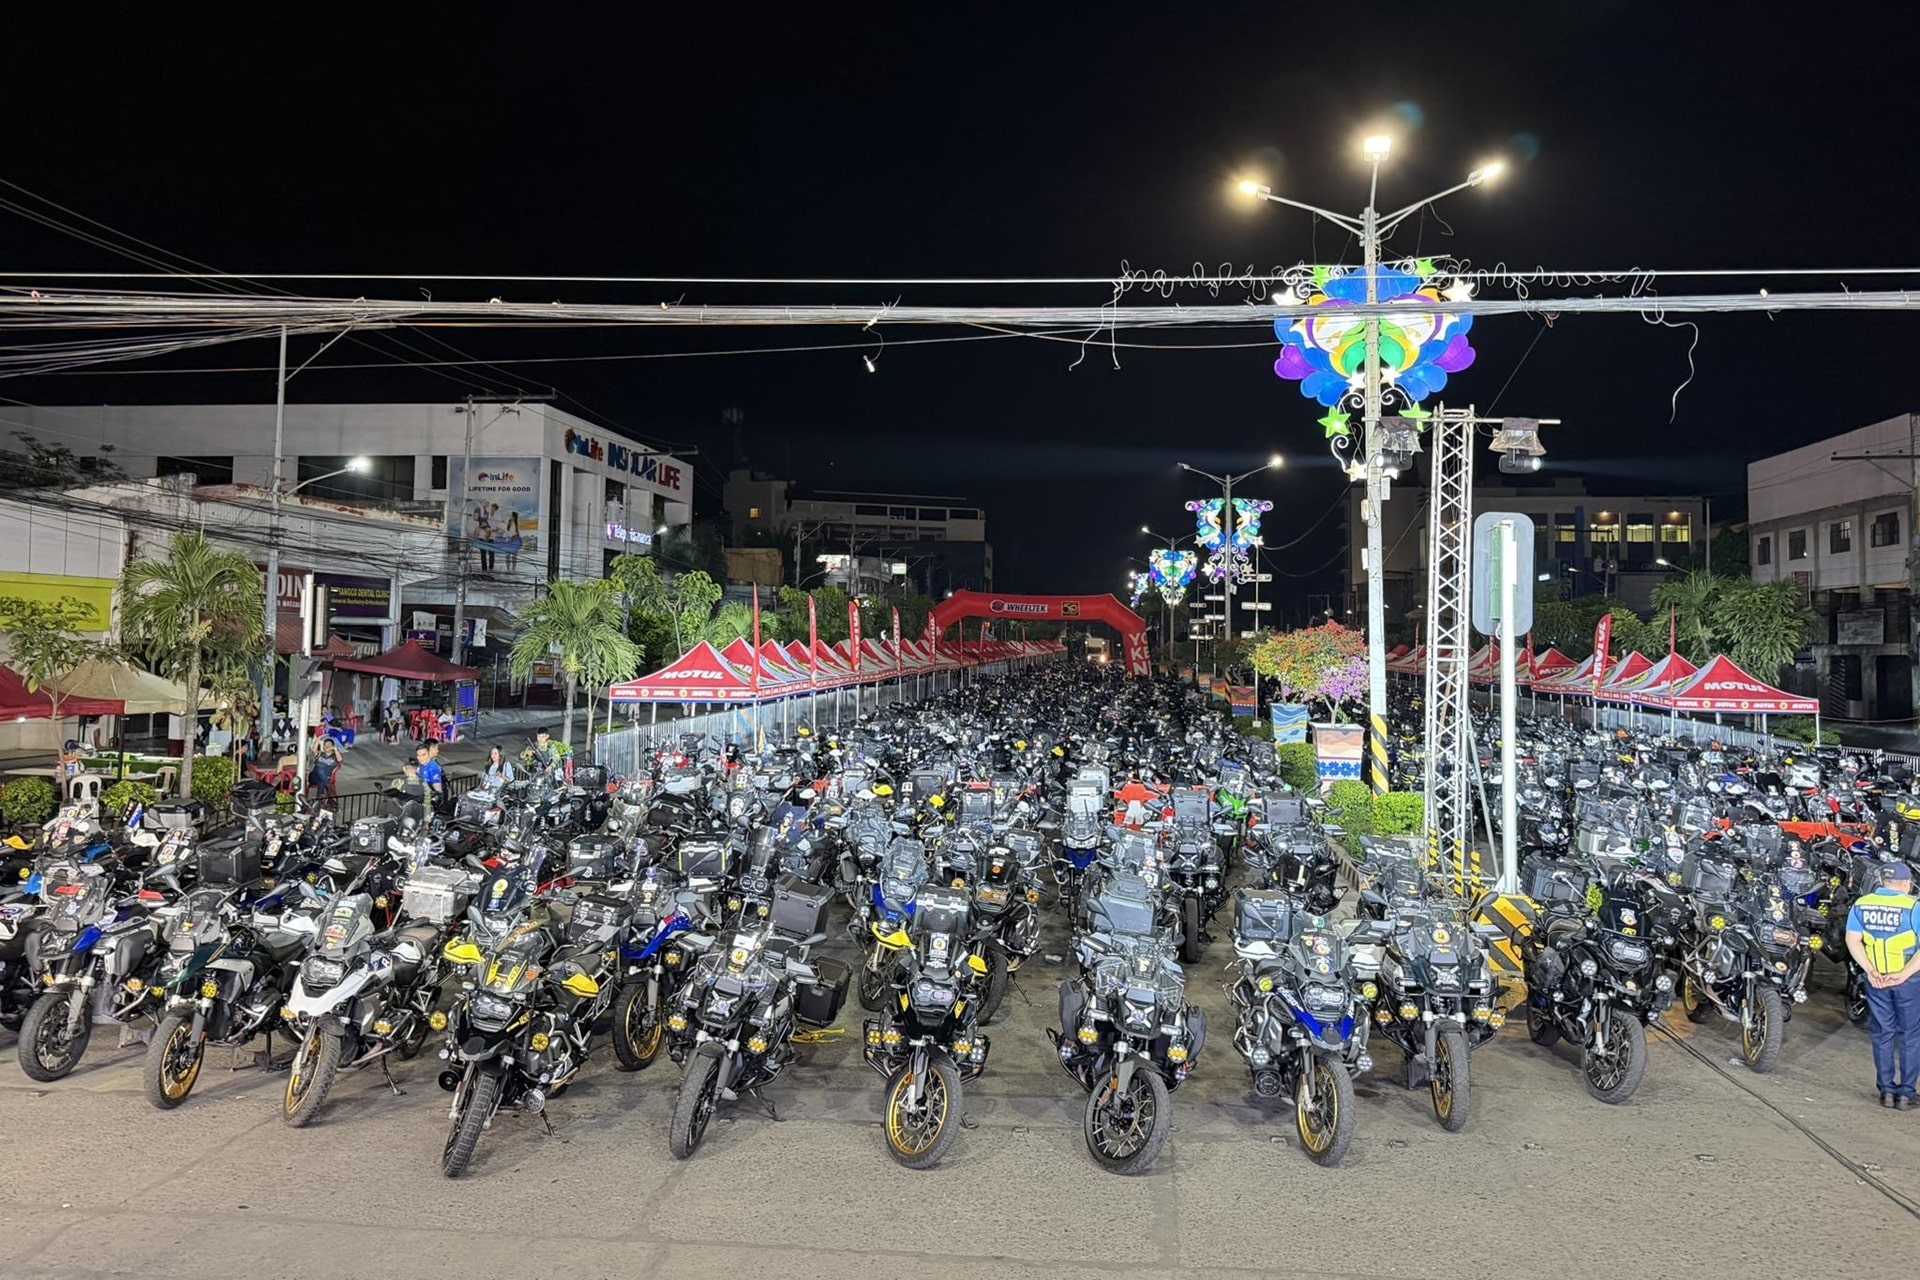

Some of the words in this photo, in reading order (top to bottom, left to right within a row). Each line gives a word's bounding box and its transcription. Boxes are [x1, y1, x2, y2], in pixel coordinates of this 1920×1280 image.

[489, 472, 514, 482] InLife
[657, 462, 680, 490] LIFE
[1007, 603, 1046, 612] WHEELTEK
[1593, 622, 1606, 677] MOTUL
[659, 669, 724, 680] MOTUL
[1703, 682, 1768, 693] MOTUL
[1863, 910, 1900, 926] POLICE
